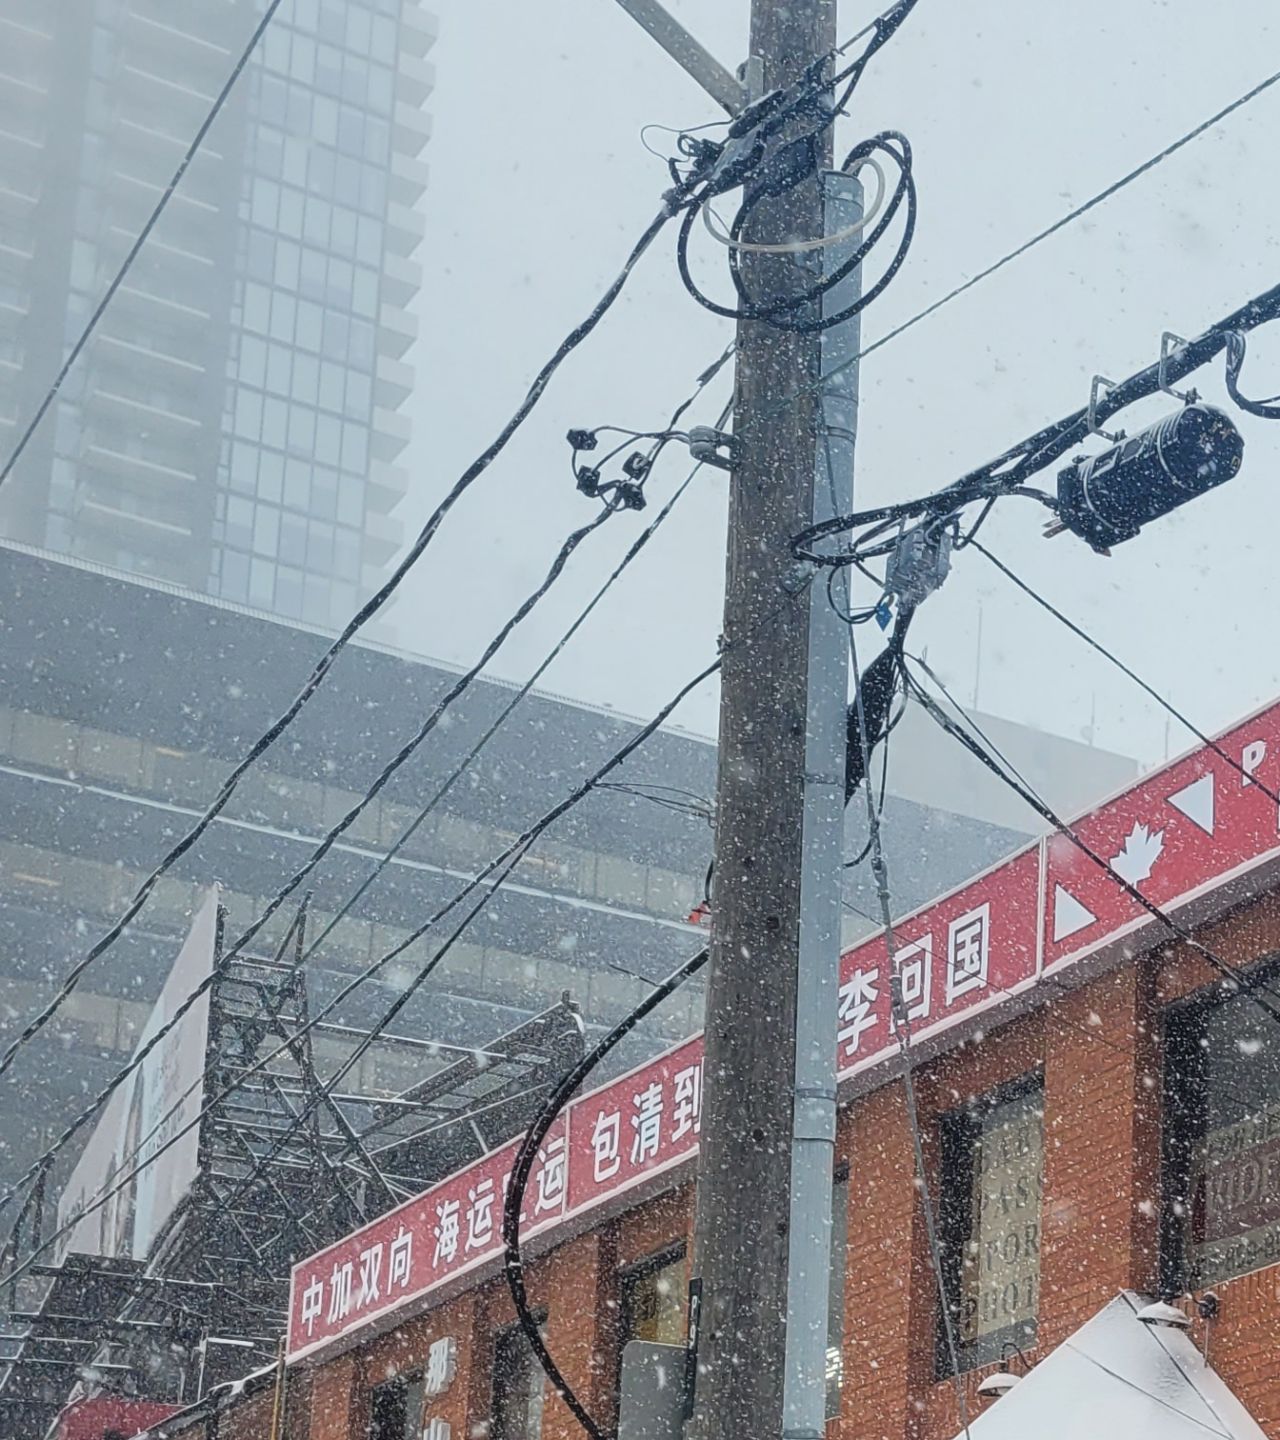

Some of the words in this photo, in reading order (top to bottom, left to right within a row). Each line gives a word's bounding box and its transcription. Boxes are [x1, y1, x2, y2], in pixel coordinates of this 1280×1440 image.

[301, 1226, 413, 1336] 中加双向
[432, 1137, 565, 1268] 海运运
